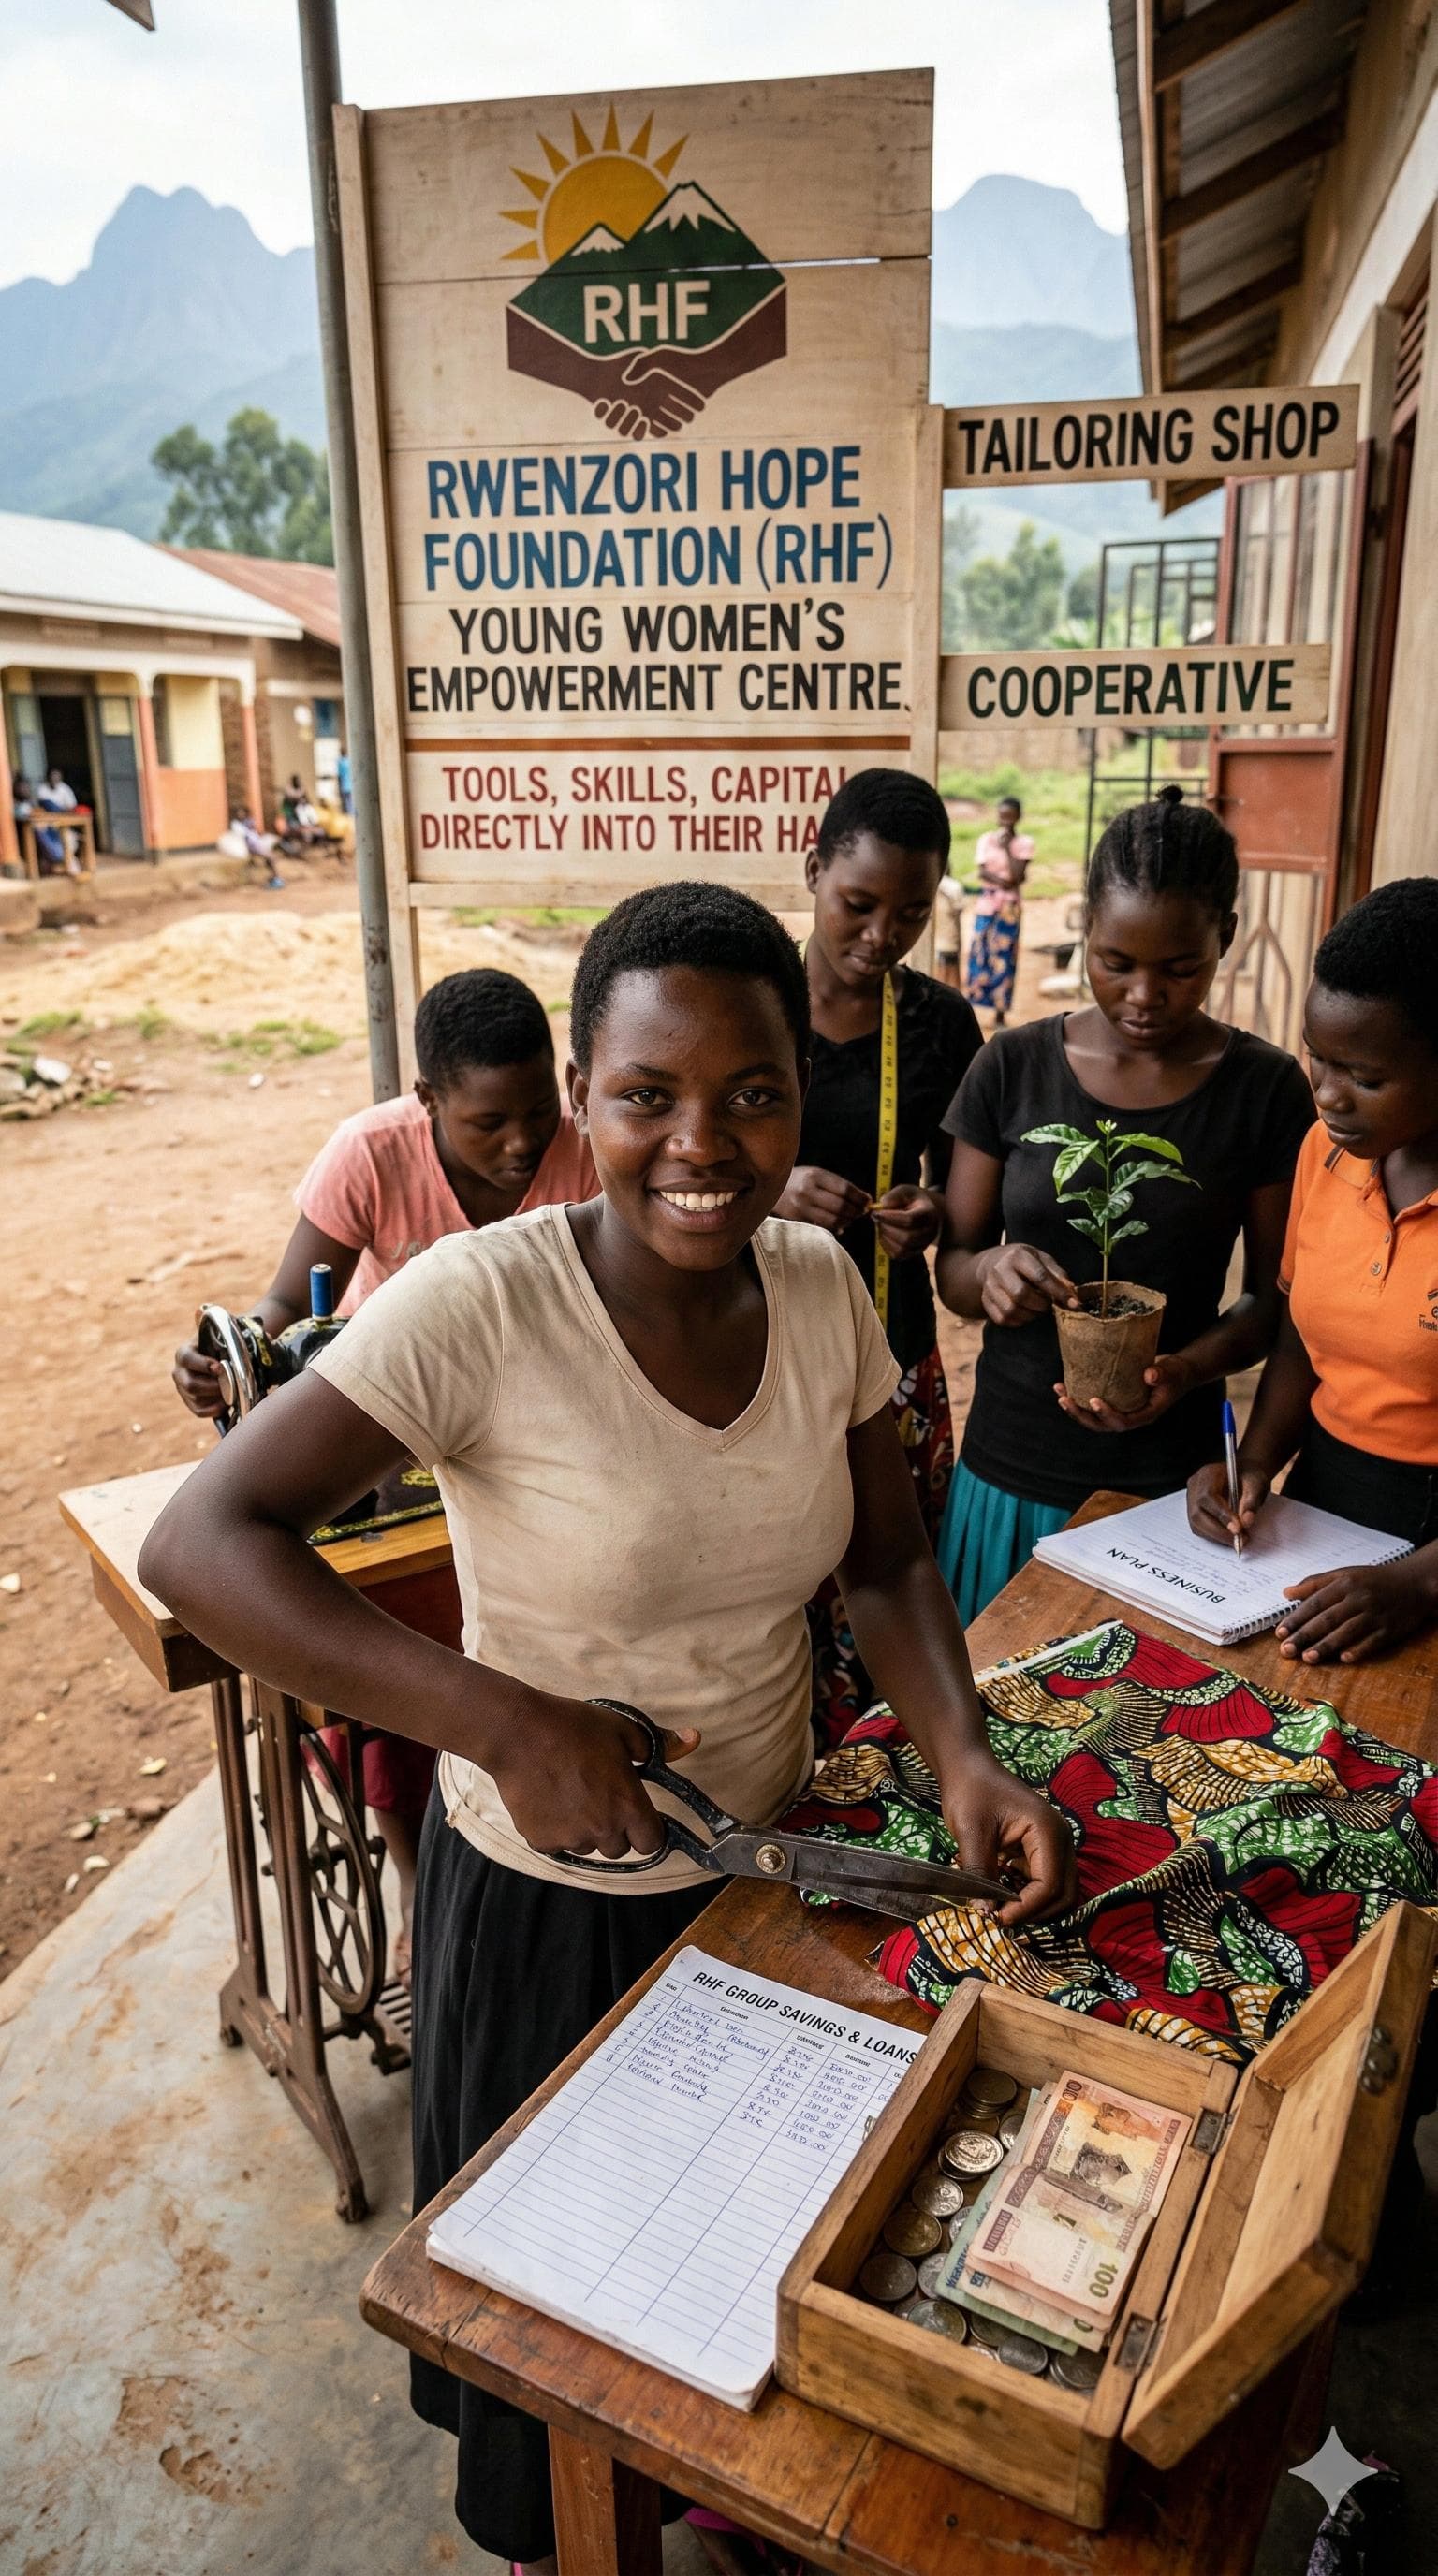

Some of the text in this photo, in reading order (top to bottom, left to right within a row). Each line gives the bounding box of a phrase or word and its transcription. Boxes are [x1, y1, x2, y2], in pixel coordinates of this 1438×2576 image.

[584, 280, 710, 344] RHF
[957, 402, 1340, 475] TAILORING SHOP
[427, 446, 861, 520] RWENZORI HOPE
[424, 512, 892, 592] FOUNDATION (RHF)
[449, 598, 844, 655] YOUNG WOMEN'S
[406, 663, 723, 713] EMPOWERMENT
[968, 659, 1295, 719] COOPERATIVE
[442, 766, 558, 807] TOOLS,
[571, 766, 697, 807] SKILLS,
[421, 814, 569, 850] DIRECTLY
[583, 814, 656, 851] INTO
[668, 814, 763, 853] THEIR
[1106, 1547, 1150, 1569] PLAN
[1148, 1566, 1226, 1603] BUSINESS
[692, 1971, 726, 1991] RHF
[726, 1984, 779, 2011] GROUP
[779, 2005, 847, 2038] SAVINGS
[847, 2030, 860, 2044] &
[863, 2036, 917, 2064] LOANS
[1088, 2261, 1119, 2299] 100
